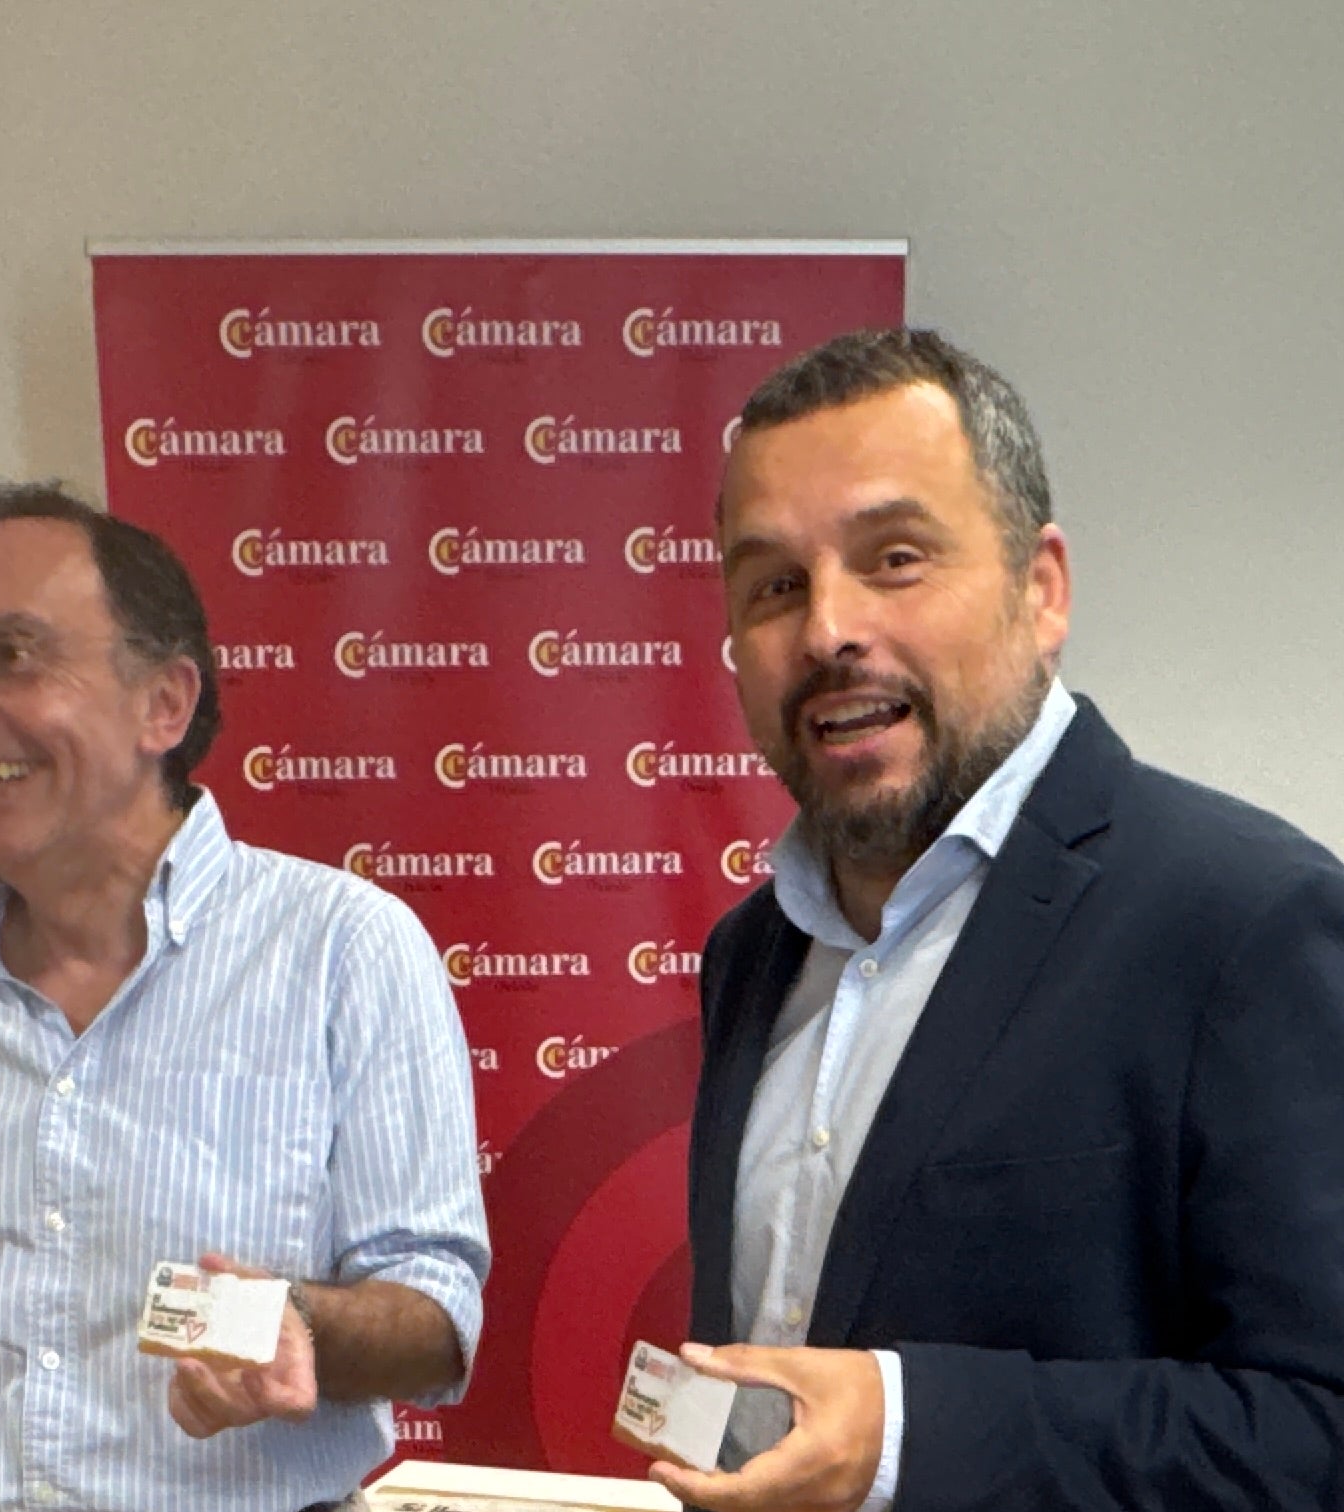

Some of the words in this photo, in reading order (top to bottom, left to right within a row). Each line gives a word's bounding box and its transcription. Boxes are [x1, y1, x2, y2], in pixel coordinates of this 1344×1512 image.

[220, 307, 380, 358] Cámara
[422, 306, 582, 358] Cámara
[622, 306, 782, 358] Cámara
[124, 416, 286, 467] Cámara
[326, 415, 484, 466] Cámara
[524, 414, 682, 465] Cámara
[232, 528, 390, 577] Cámara
[428, 526, 585, 576] Cámara
[624, 525, 722, 574] Cám
[334, 630, 490, 679] Cámara
[528, 628, 682, 678] Cámara
[242, 744, 396, 791] Cámara
[434, 742, 588, 789] Cámara
[532, 839, 683, 886] Cámara
[442, 941, 591, 987] Cámara
[627, 939, 702, 985] Cám
